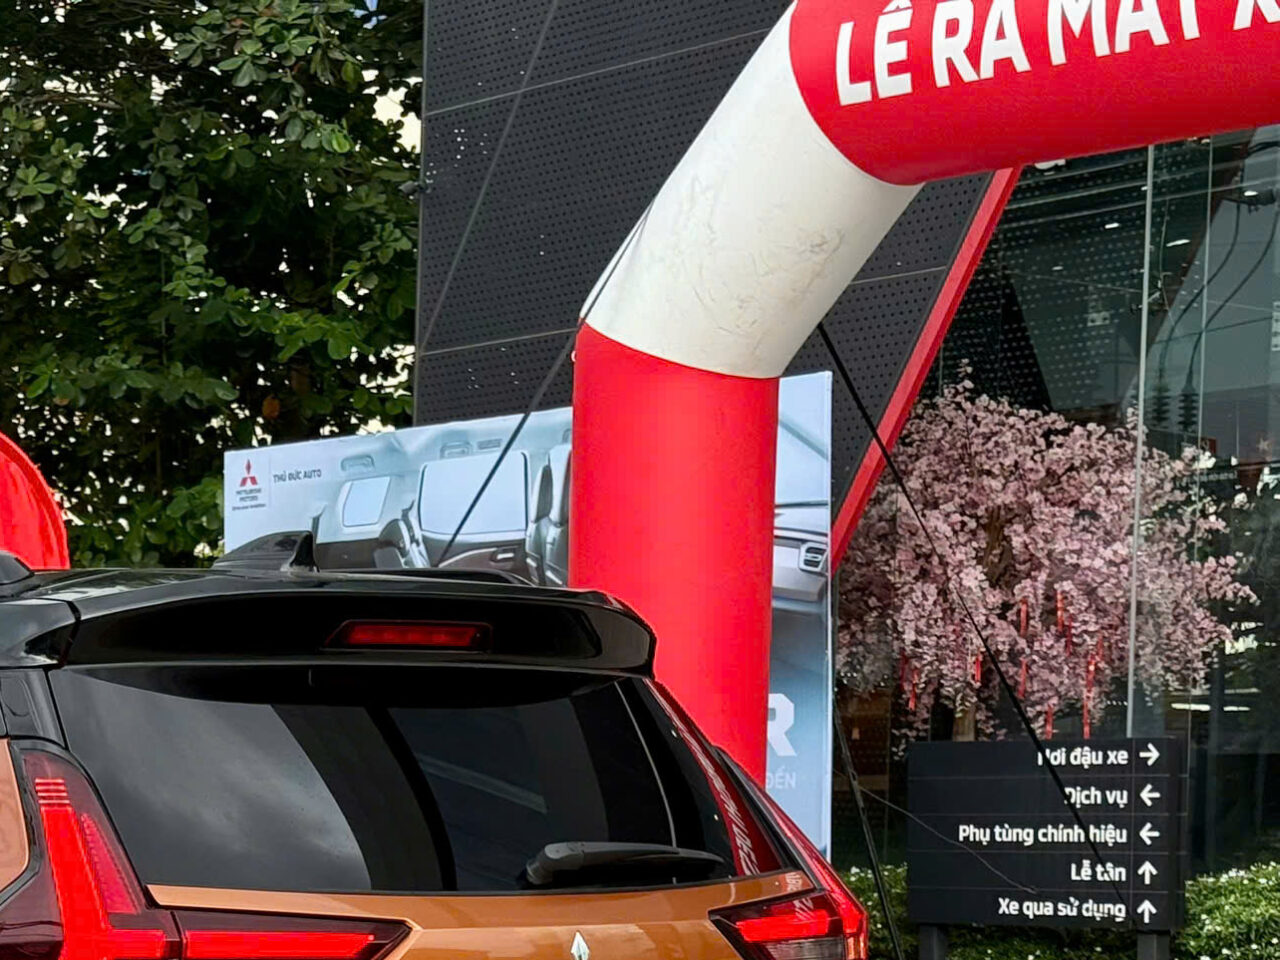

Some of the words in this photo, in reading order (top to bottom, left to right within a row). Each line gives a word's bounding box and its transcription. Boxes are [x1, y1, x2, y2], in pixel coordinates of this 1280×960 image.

[931, 0, 1031, 89] RA
[1070, 746, 1102, 769] đậu
[1106, 750, 1128, 765] xe
[1064, 786, 1101, 808] Dịch
[1105, 789, 1128, 808] vụ
[958, 824, 990, 845] Phụ
[994, 823, 1034, 846] tùng
[1038, 823, 1085, 842] chính
[1089, 823, 1127, 847] hiệu
[1071, 859, 1091, 881] Lễ
[1095, 862, 1126, 882] tân
[998, 898, 1019, 915] Xe
[1022, 900, 1054, 919] qua
[1057, 897, 1080, 917] sử
[1082, 900, 1126, 922] dụng
